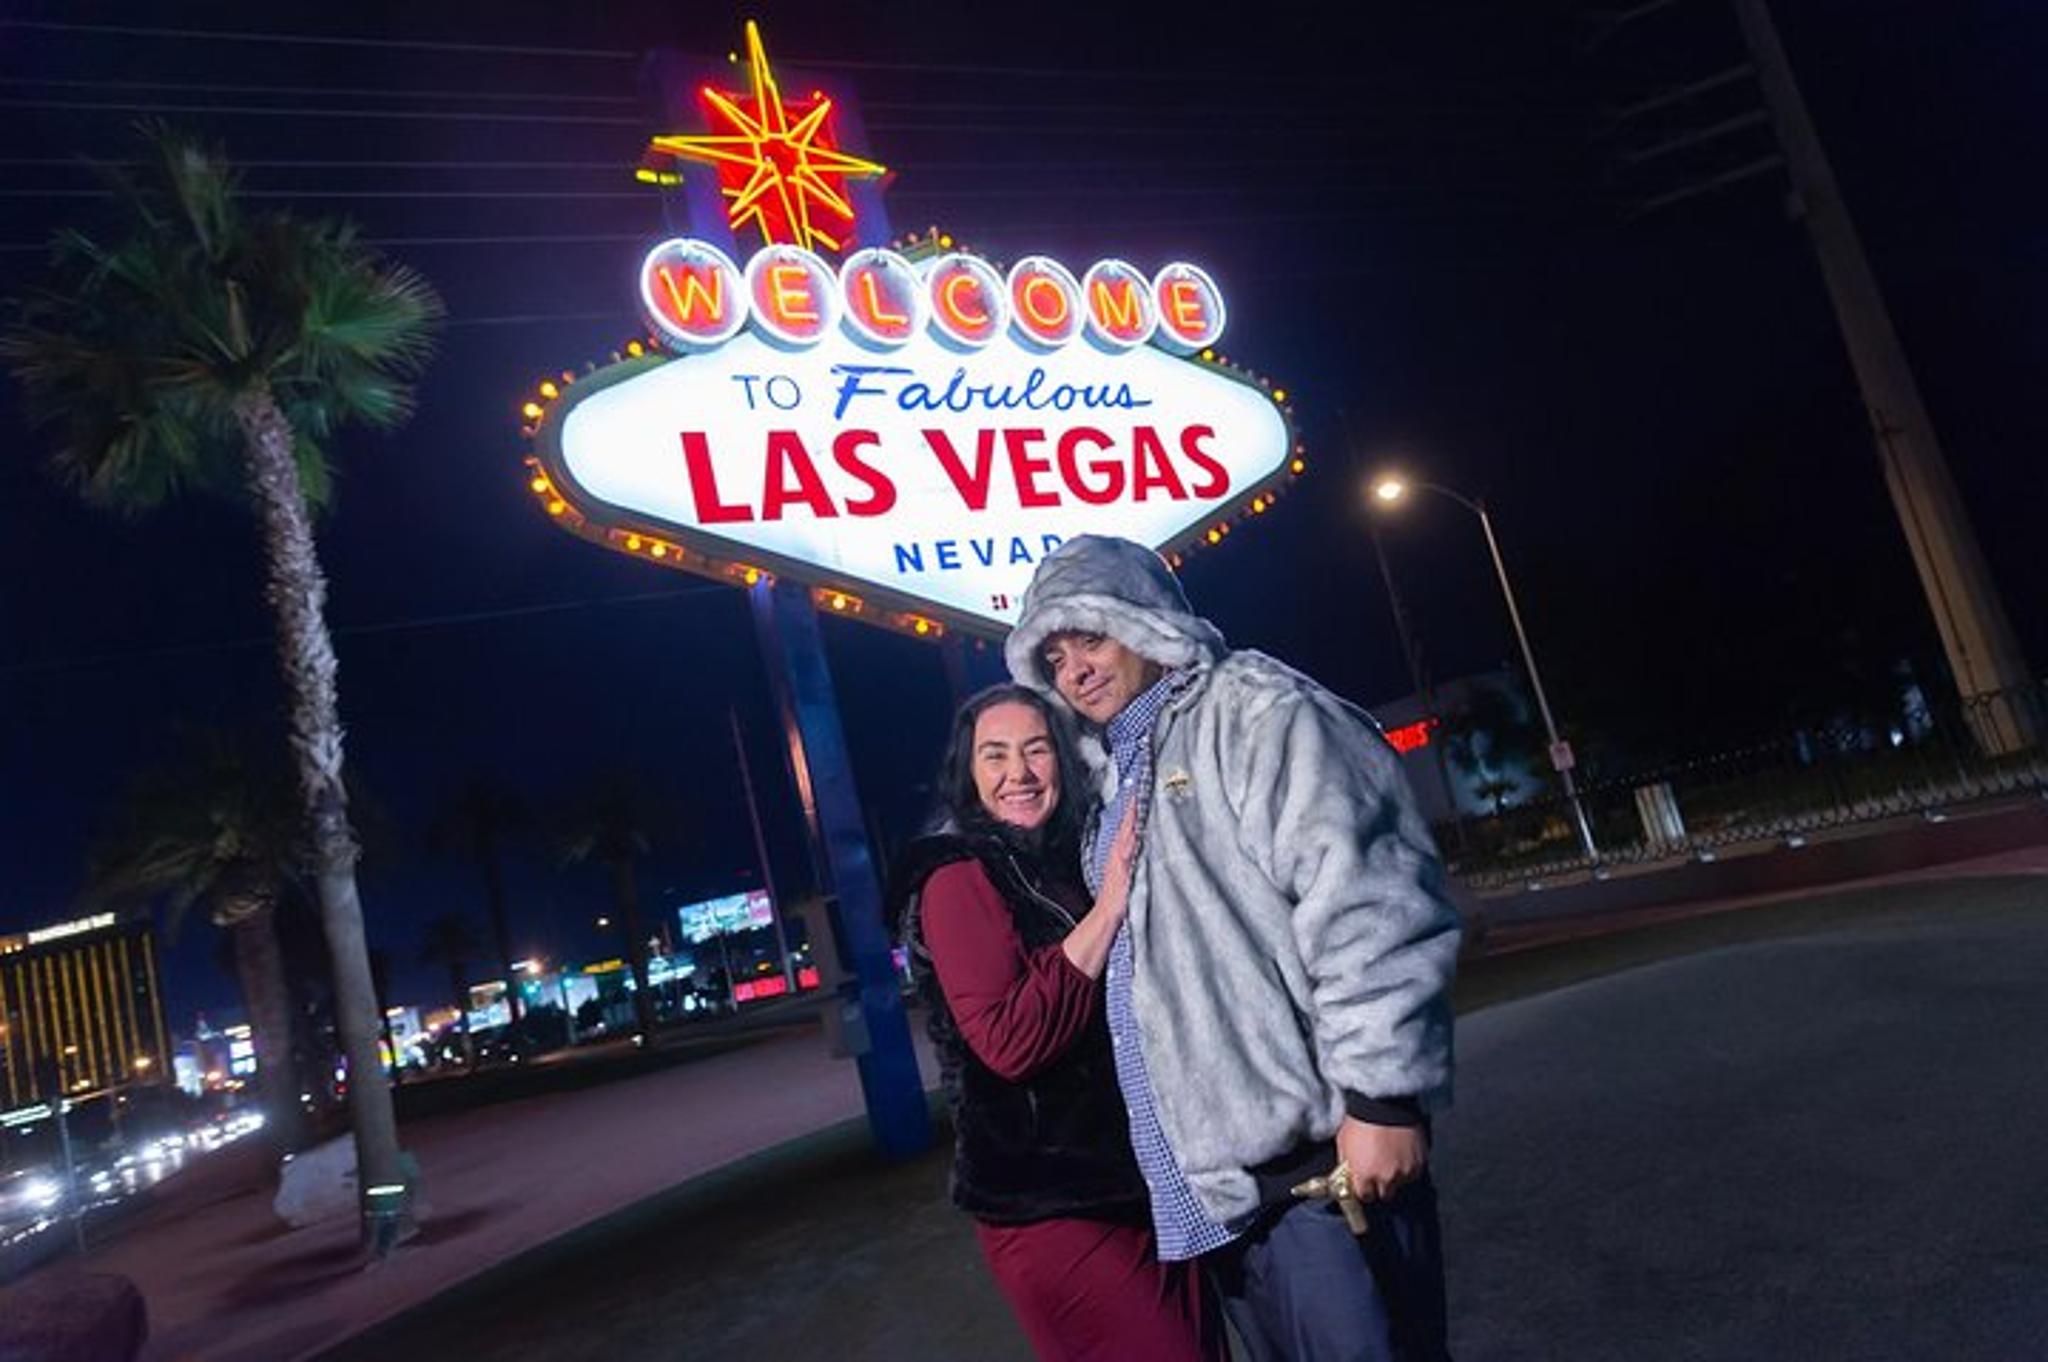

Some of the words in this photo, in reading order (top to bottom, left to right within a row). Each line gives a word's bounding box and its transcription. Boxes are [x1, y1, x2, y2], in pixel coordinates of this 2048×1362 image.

[657, 263, 1207, 330] WELCOME
[732, 375, 801, 410] TO
[830, 365, 1152, 419] Fabulous
[681, 430, 897, 524] LAS
[921, 425, 1231, 511] VEGAS
[893, 534, 1063, 573] NEVAD
